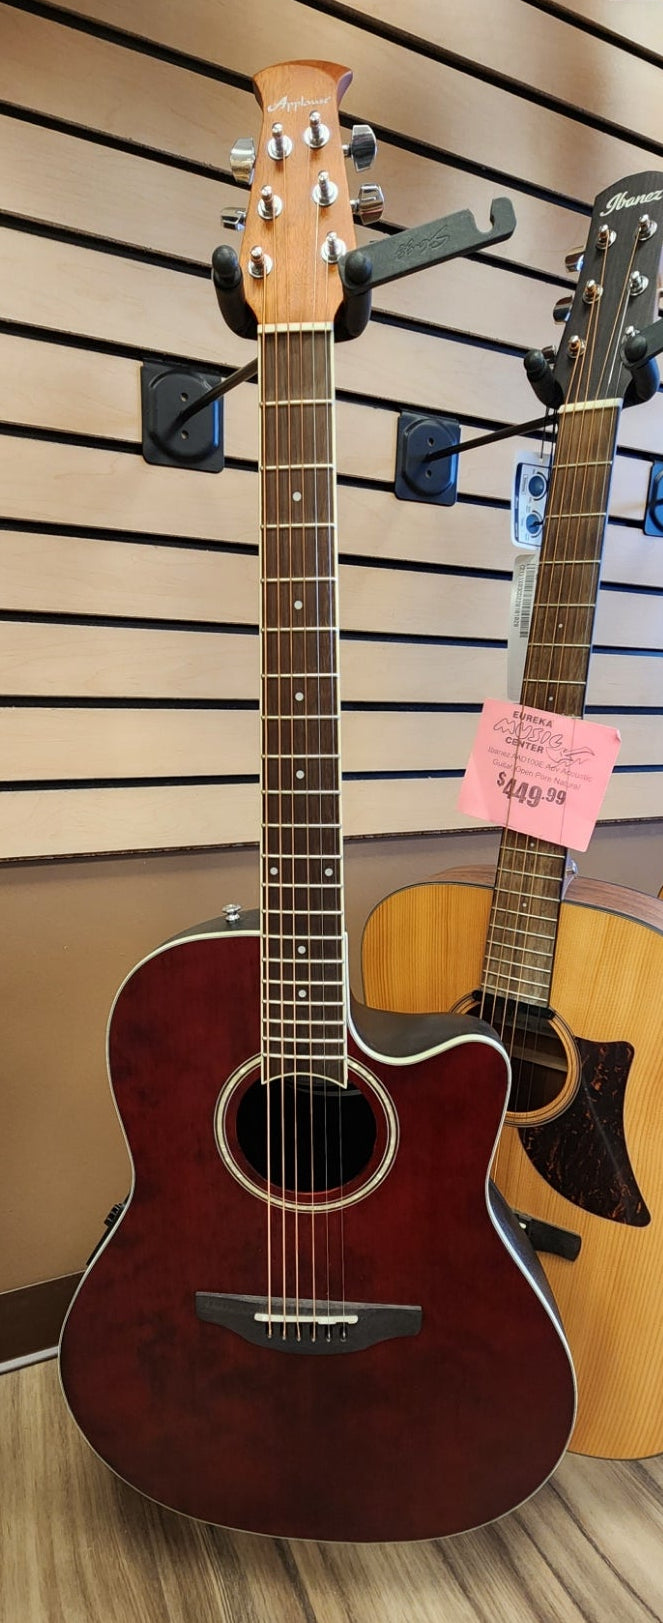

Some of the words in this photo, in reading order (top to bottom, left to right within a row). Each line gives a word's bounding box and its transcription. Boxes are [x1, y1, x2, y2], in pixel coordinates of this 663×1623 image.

[267, 95, 331, 113] Applause
[599, 190, 663, 217] Ibanez
[513, 711, 552, 728] EUREKA
[493, 718, 563, 748] MUSIC
[488, 746, 511, 758] Ibanez
[505, 736, 544, 753] CENTER
[516, 766, 534, 777] Open
[496, 771, 567, 807] $449.99
